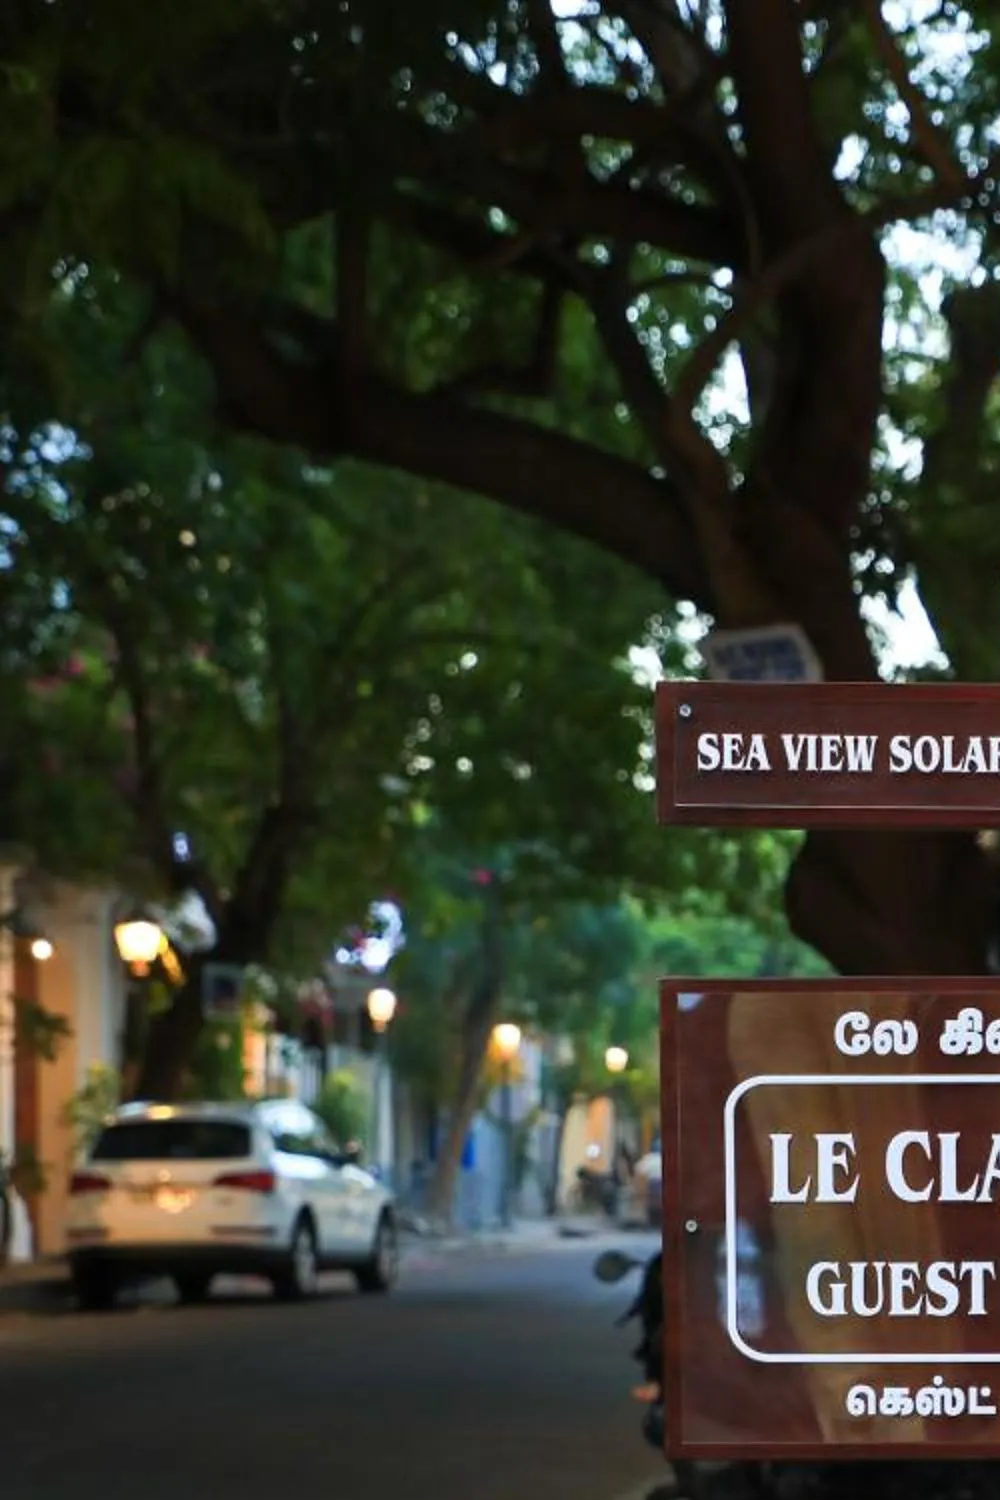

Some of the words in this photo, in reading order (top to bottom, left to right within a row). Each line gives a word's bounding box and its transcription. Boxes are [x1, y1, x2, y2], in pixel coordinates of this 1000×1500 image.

[697, 733, 771, 771] SEA
[781, 733, 878, 771] VIEW
[834, 1011, 919, 1056] லே
[769, 1132, 859, 1203] LE
[806, 1261, 995, 1317] GUEST
[846, 1375, 997, 1417] கெஸ்ட்
